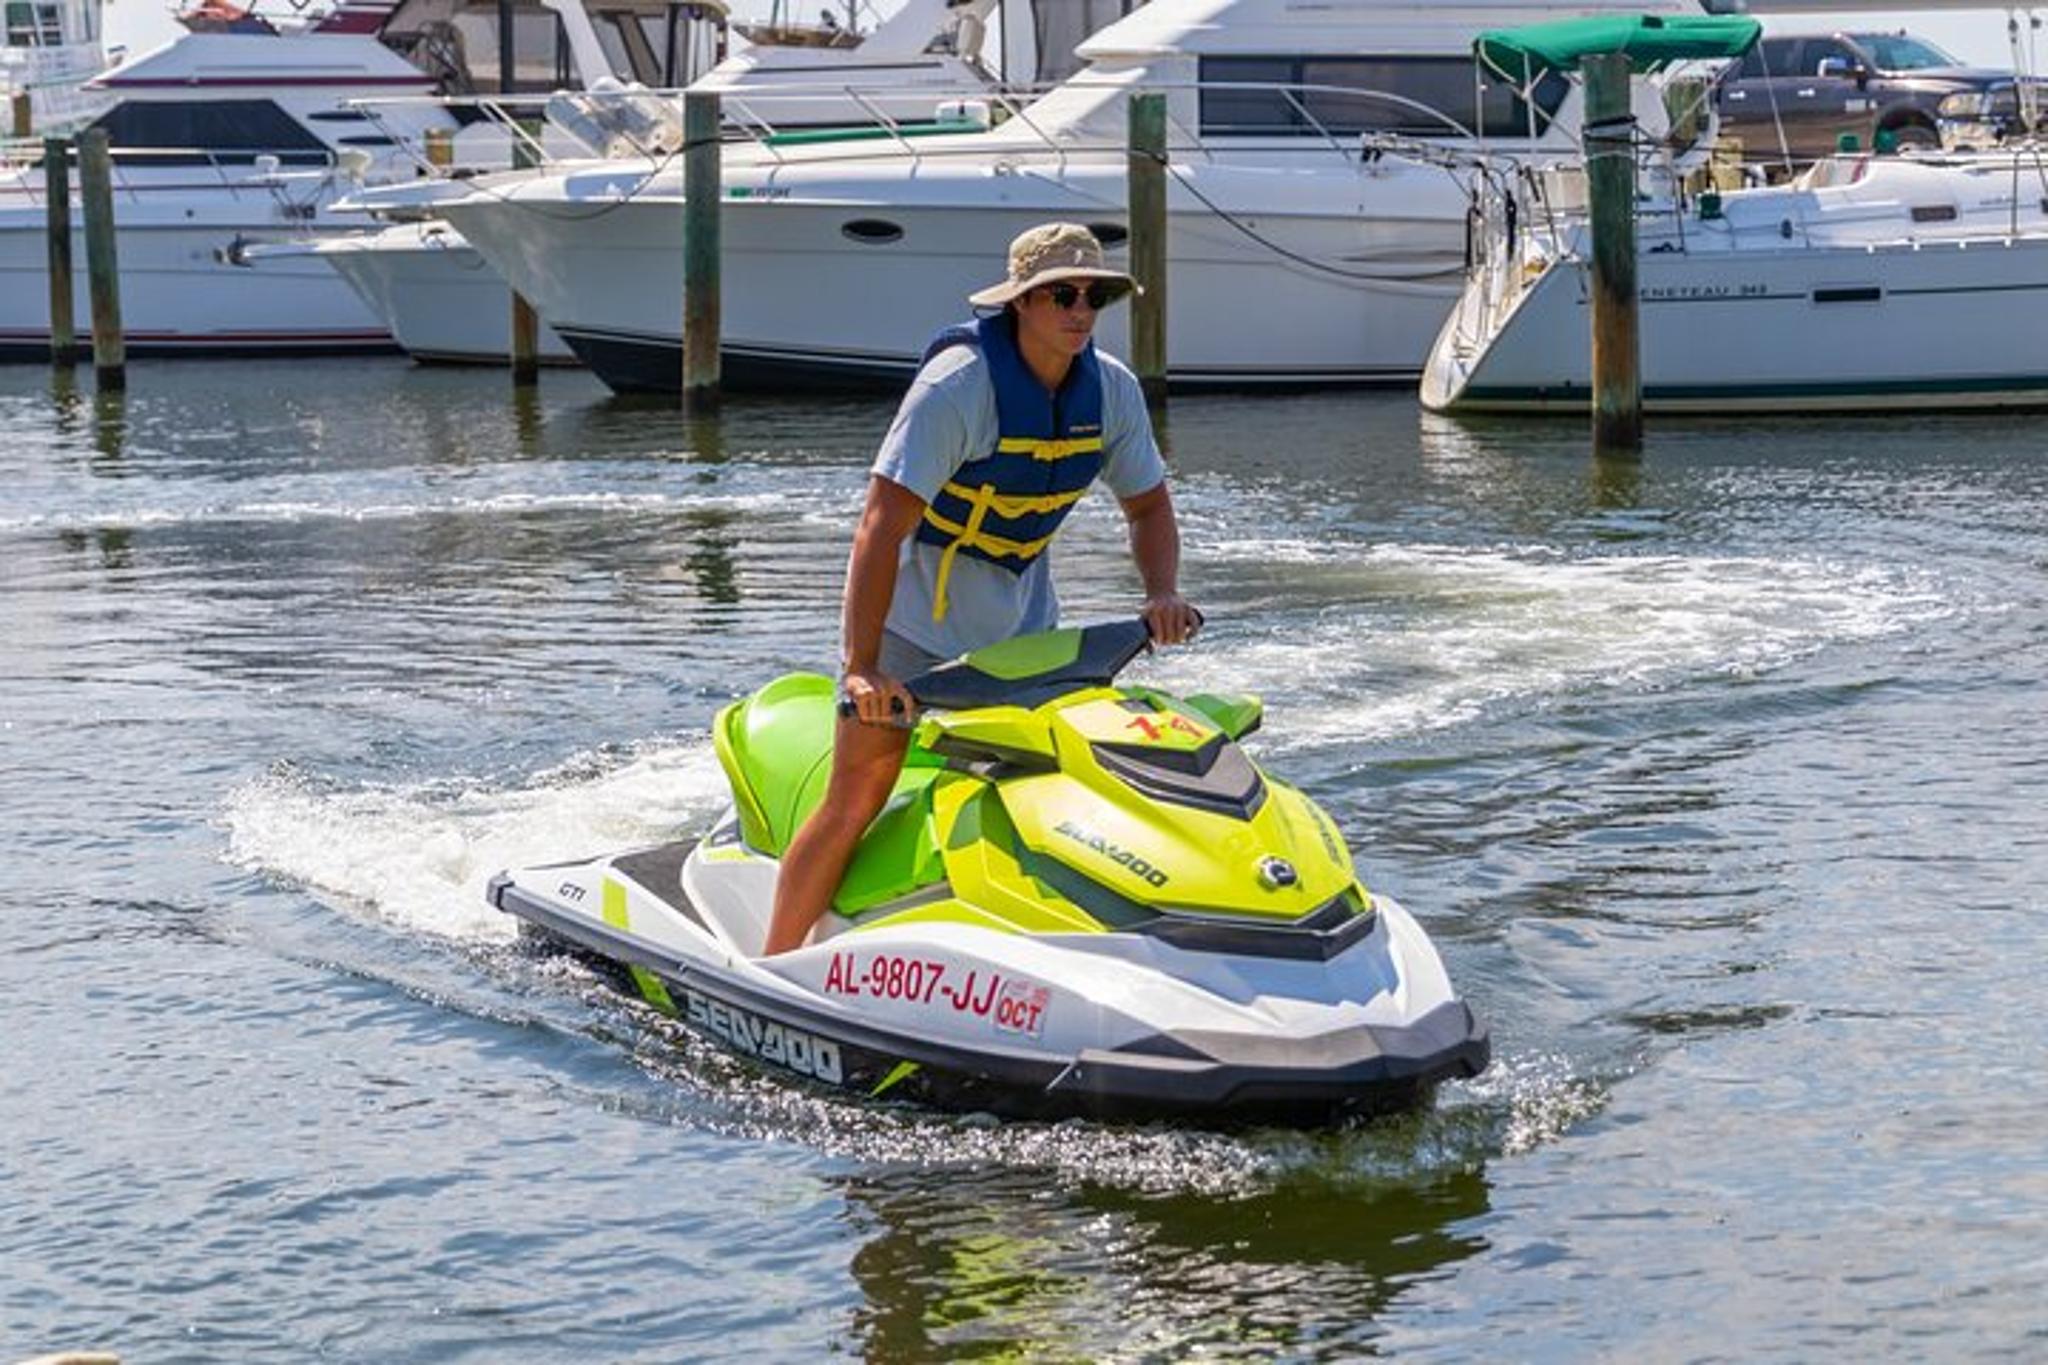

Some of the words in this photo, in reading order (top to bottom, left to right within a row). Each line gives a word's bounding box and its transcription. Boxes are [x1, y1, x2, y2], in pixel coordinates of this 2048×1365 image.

[1640, 286, 1729, 298] ENETEAU
[559, 882, 586, 901] GTI
[825, 952, 999, 1015] AL-9807-JJ
[997, 996, 1042, 1031] OCT
